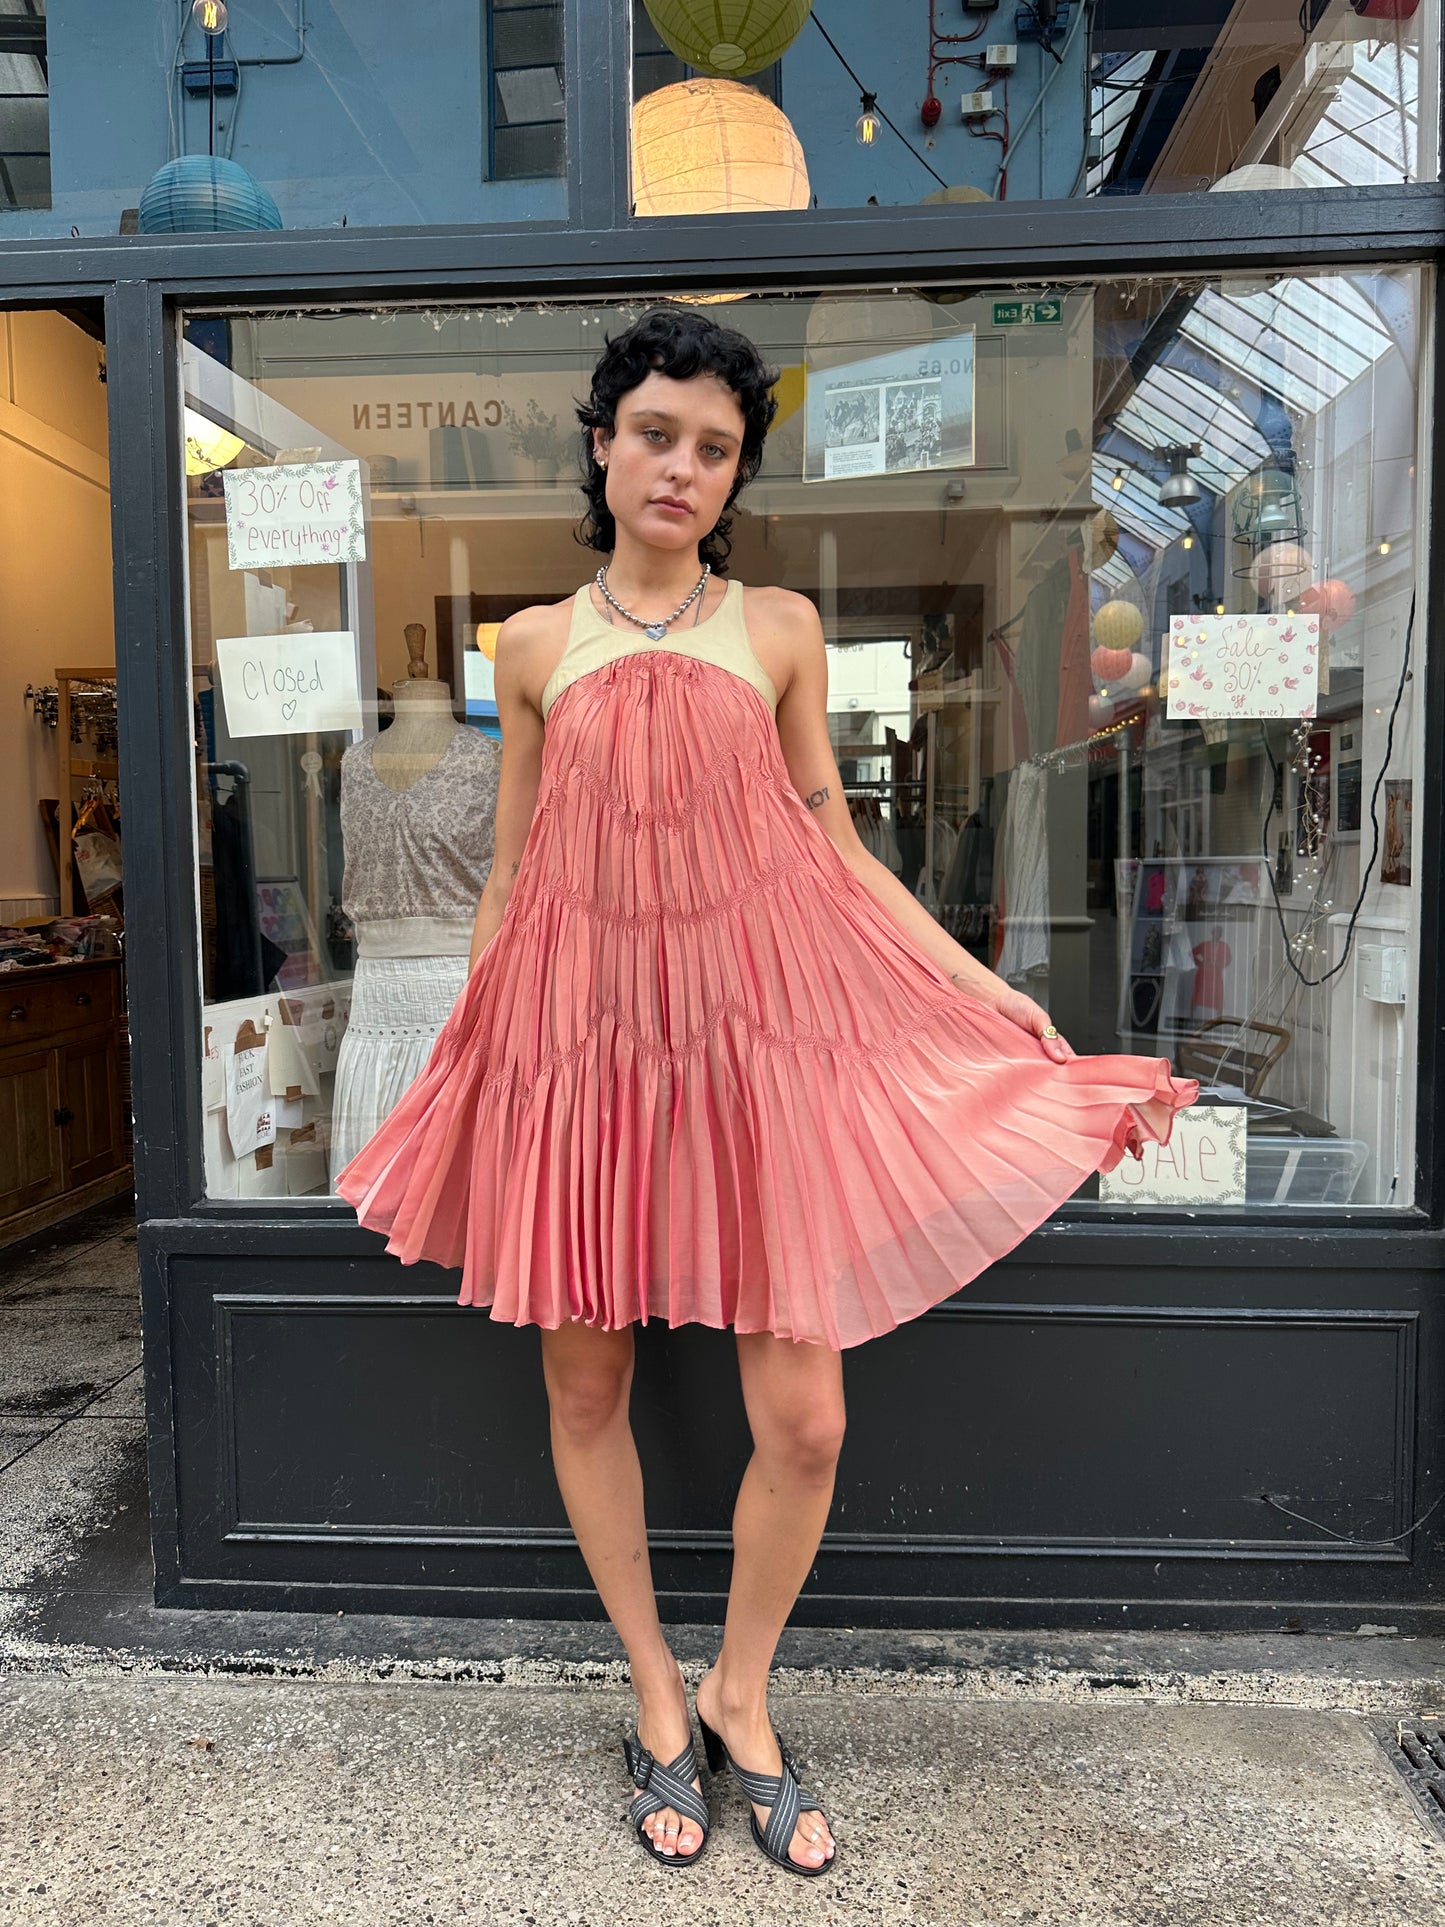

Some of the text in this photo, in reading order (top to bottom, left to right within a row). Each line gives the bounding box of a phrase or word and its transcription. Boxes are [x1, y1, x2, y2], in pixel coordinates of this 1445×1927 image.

[239, 480, 288, 517] 30%
[247, 523, 341, 557] everything
[1216, 625, 1276, 659] Sale
[242, 659, 324, 701] Closed
[1223, 661, 1263, 693] 30%
[1230, 694, 1246, 709] off
[235, 1074, 264, 1096] FASHION
[239, 1062, 255, 1079] FAST
